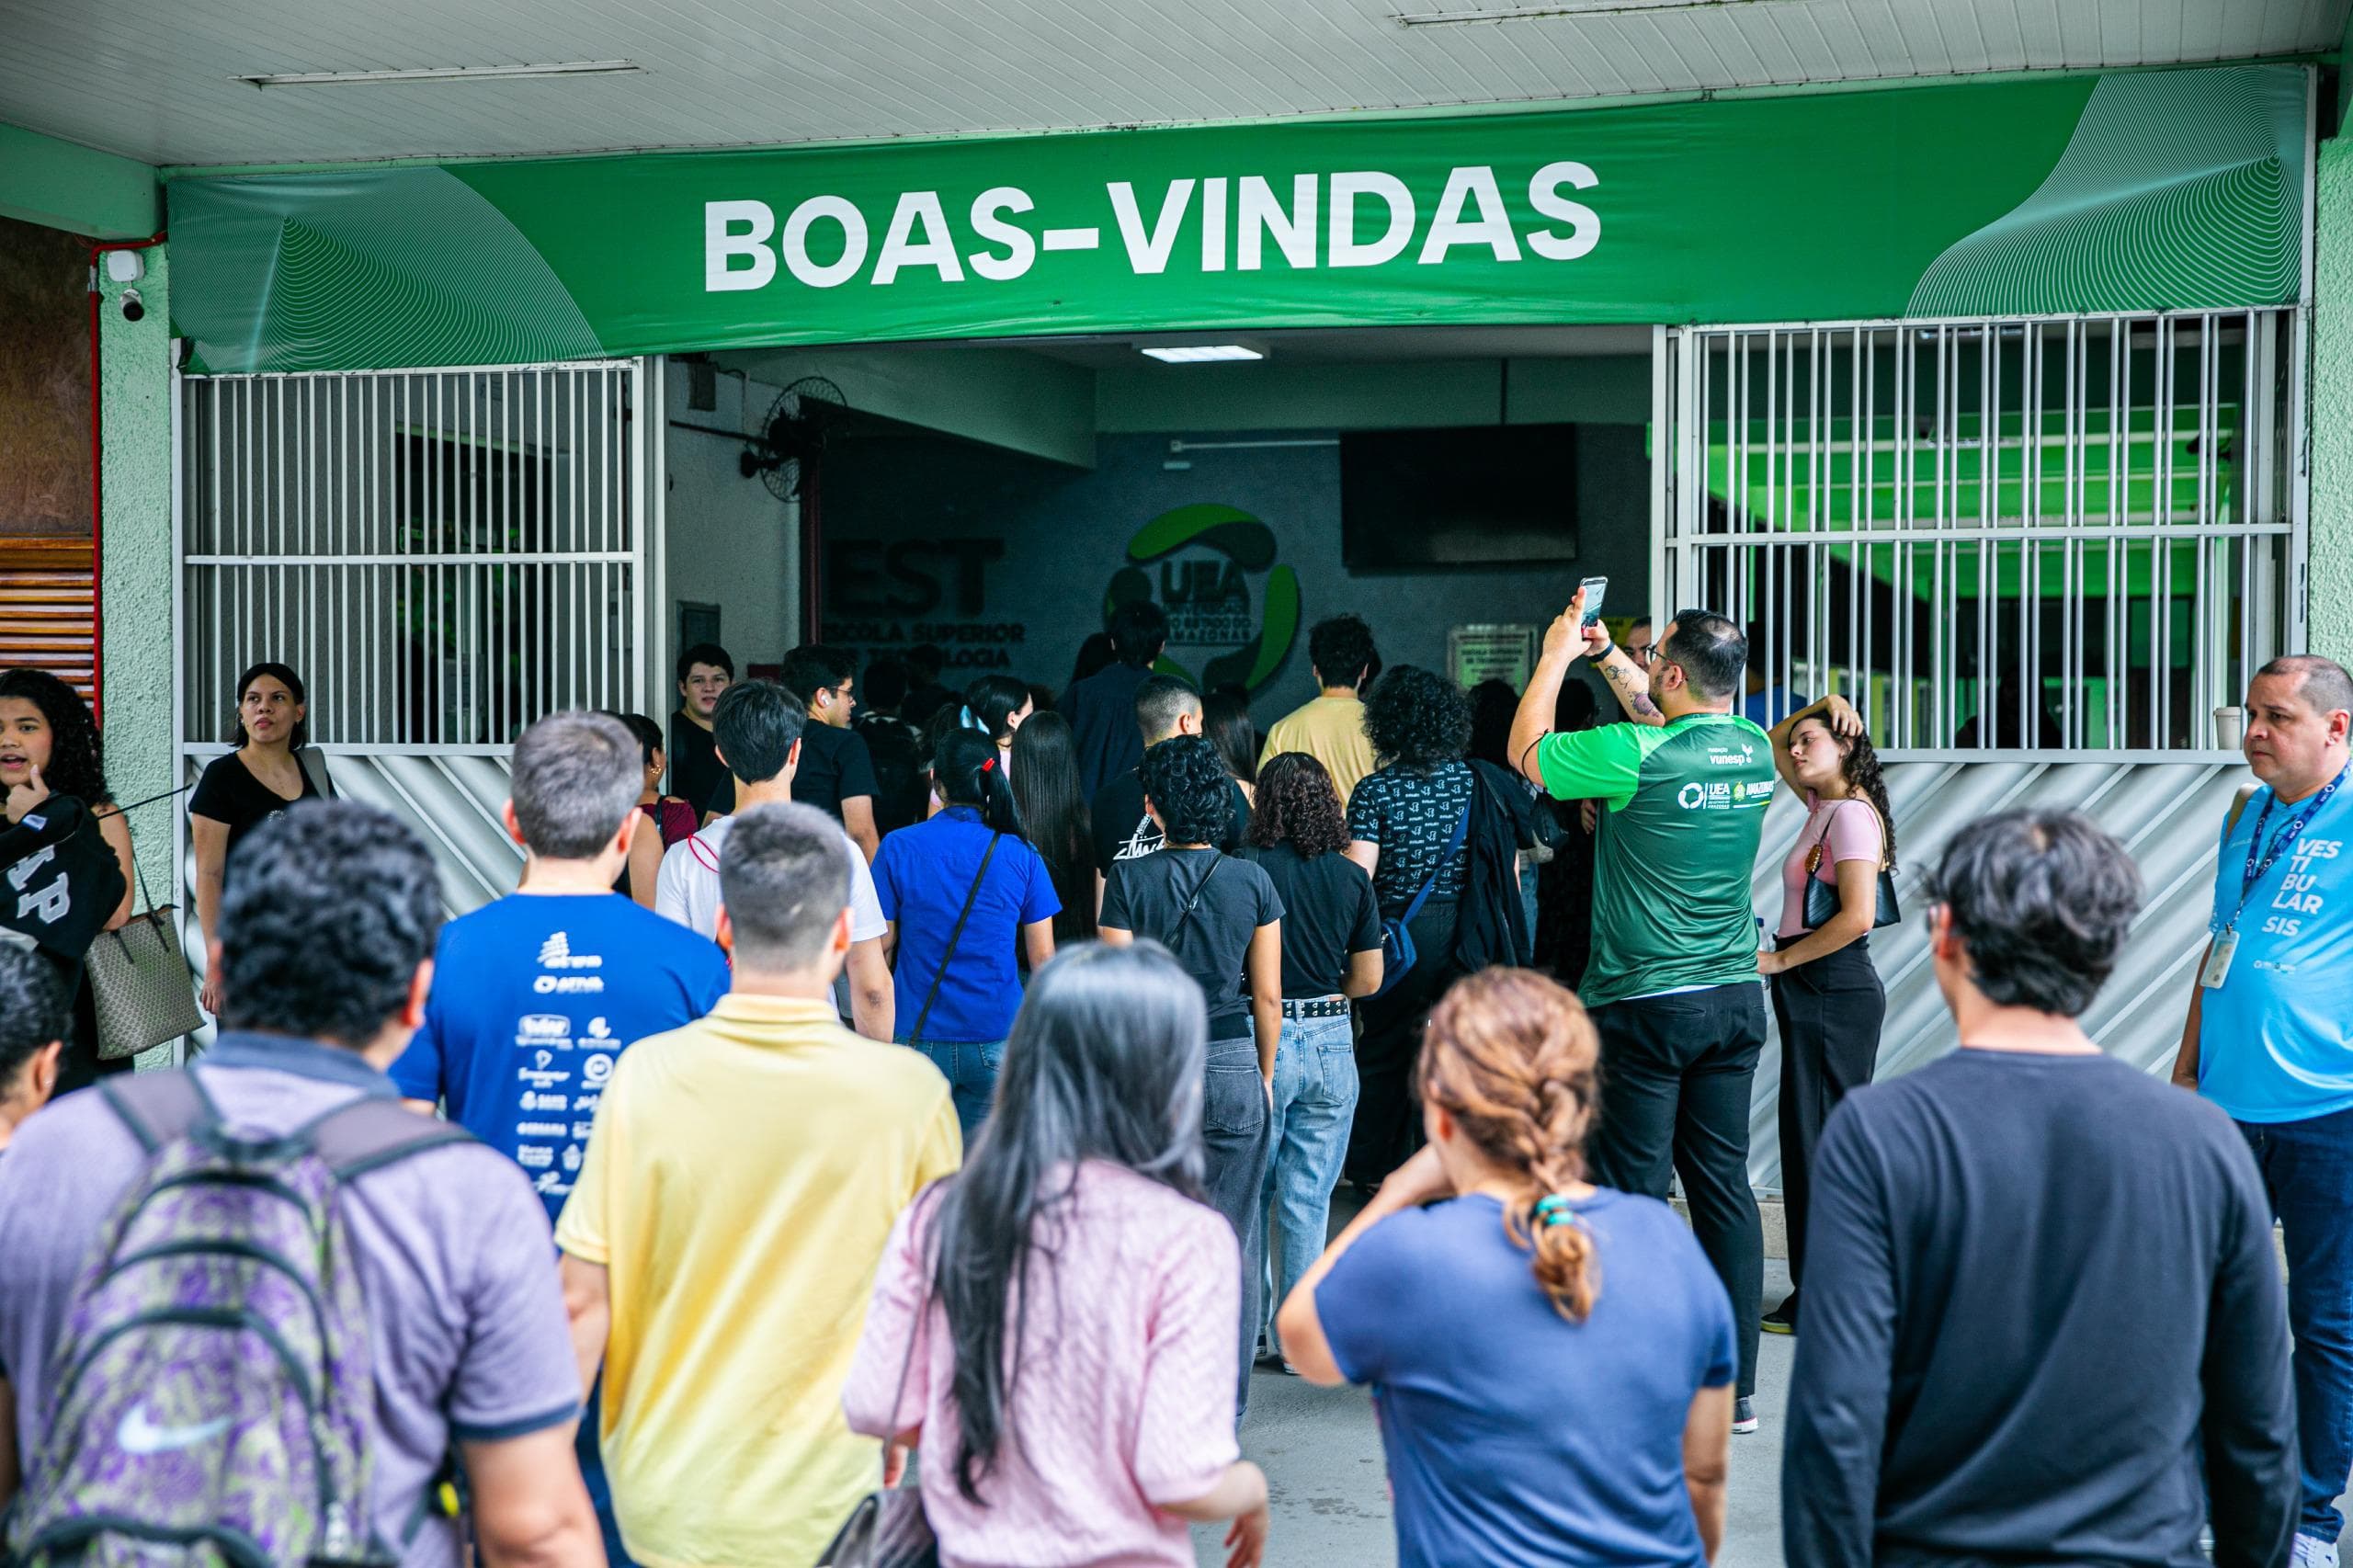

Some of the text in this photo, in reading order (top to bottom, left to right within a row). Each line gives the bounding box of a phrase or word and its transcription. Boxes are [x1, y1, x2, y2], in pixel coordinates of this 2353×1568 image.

[704, 160, 1602, 292] BOAS-VINDAS
[829, 537, 1005, 616] EST
[1161, 560, 1250, 603] UEA
[823, 622, 1027, 642] ESCOLA SUPERIOR
[1710, 755, 1745, 766] vunesp
[1709, 783, 1730, 795] UEA
[2296, 837, 2344, 858] VES
[2290, 855, 2313, 873] TI
[2280, 873, 2317, 892] BU
[2271, 892, 2325, 915] LAR
[2261, 915, 2302, 937] SIS
